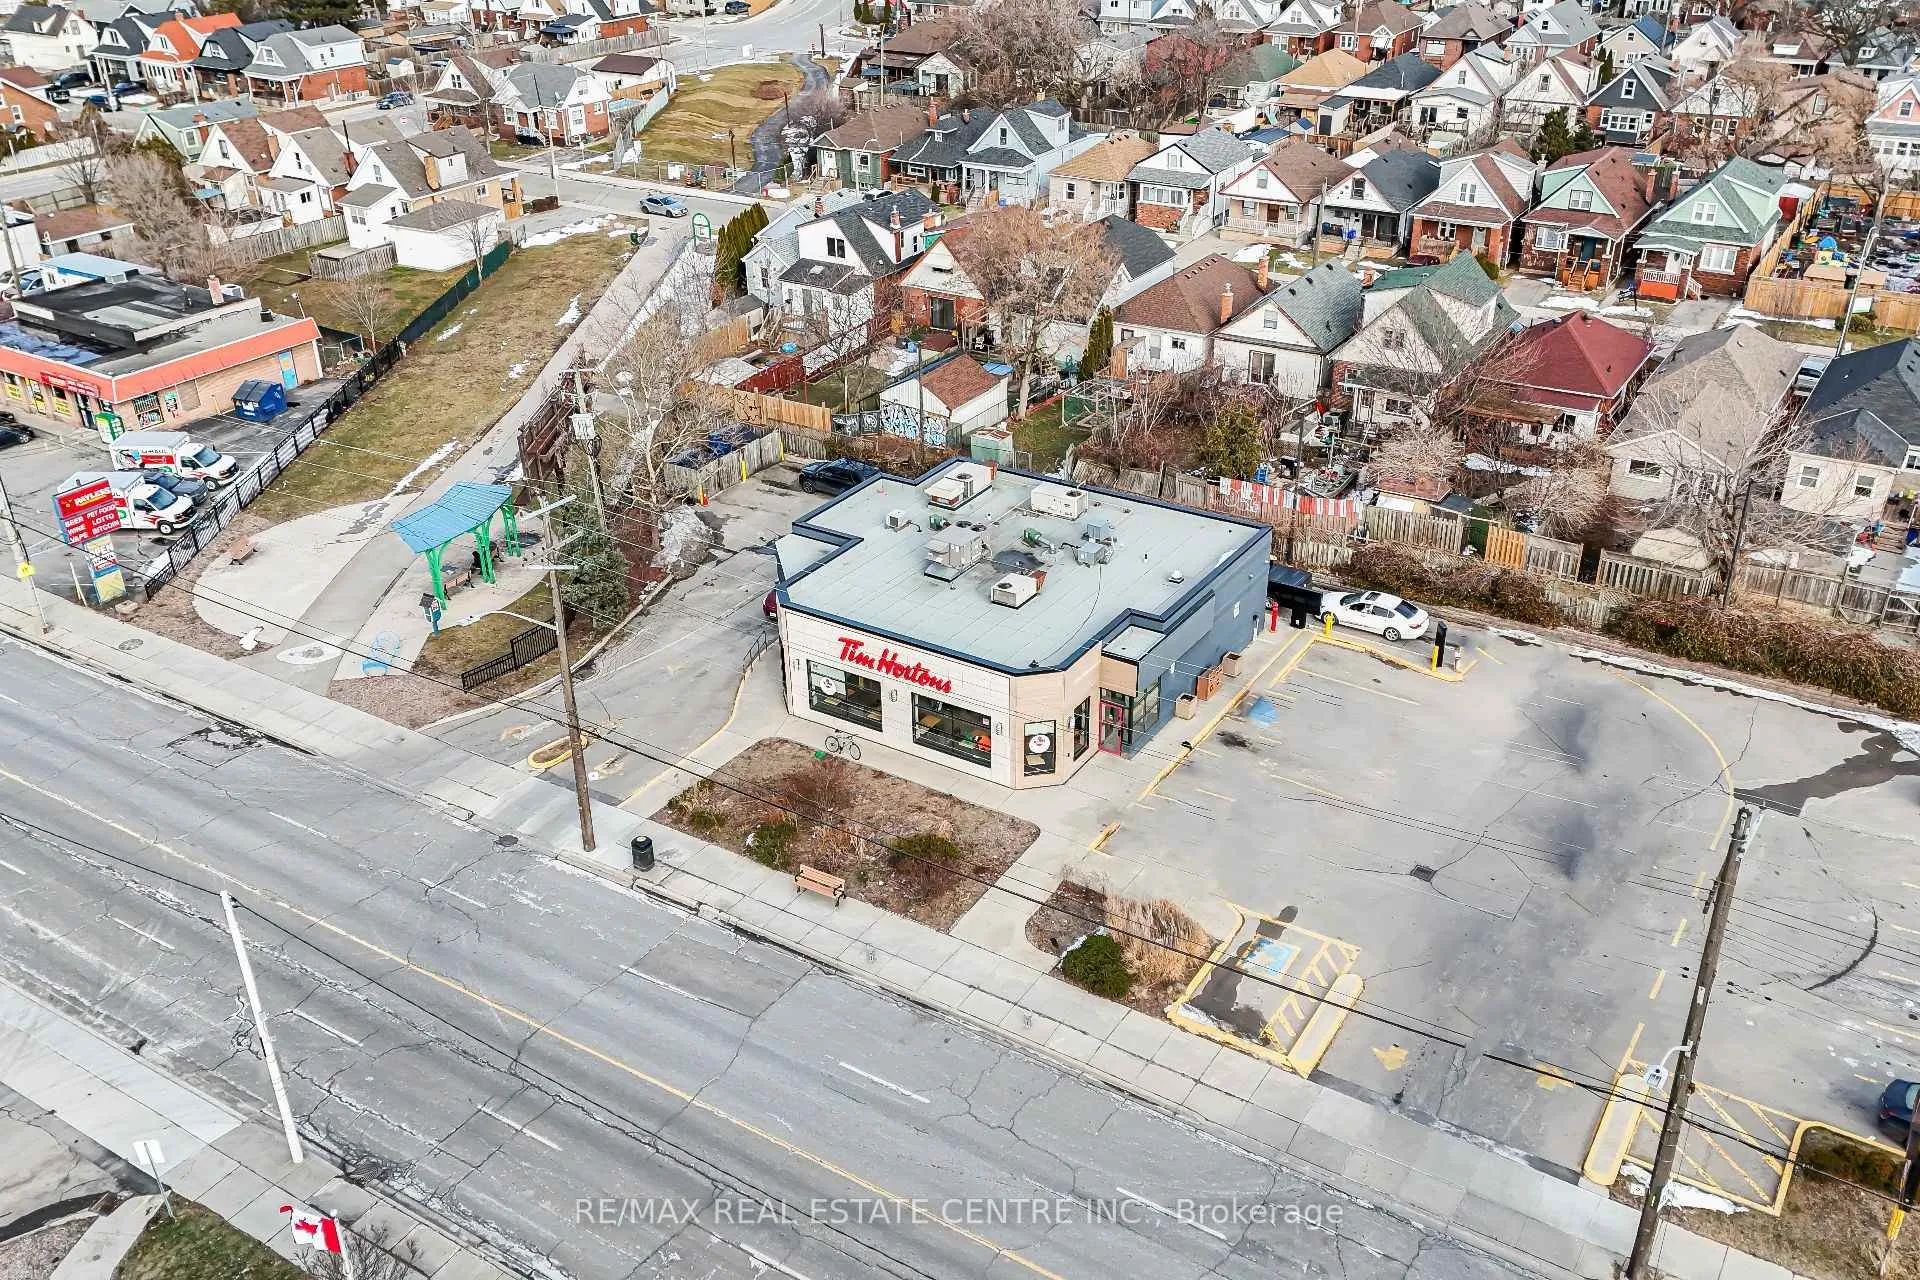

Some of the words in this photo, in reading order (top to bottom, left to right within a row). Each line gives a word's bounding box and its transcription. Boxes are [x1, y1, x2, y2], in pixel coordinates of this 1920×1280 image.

[74, 487, 111, 506] PAYLESS
[98, 504, 116, 515] FOOD
[64, 516, 84, 528] BEER
[91, 513, 115, 526] LOTTO
[67, 524, 86, 535] WINE
[91, 520, 120, 535] BITCOIN
[70, 532, 89, 543] VAPE
[838, 637, 875, 669] Tim
[877, 648, 952, 693] Hortons
